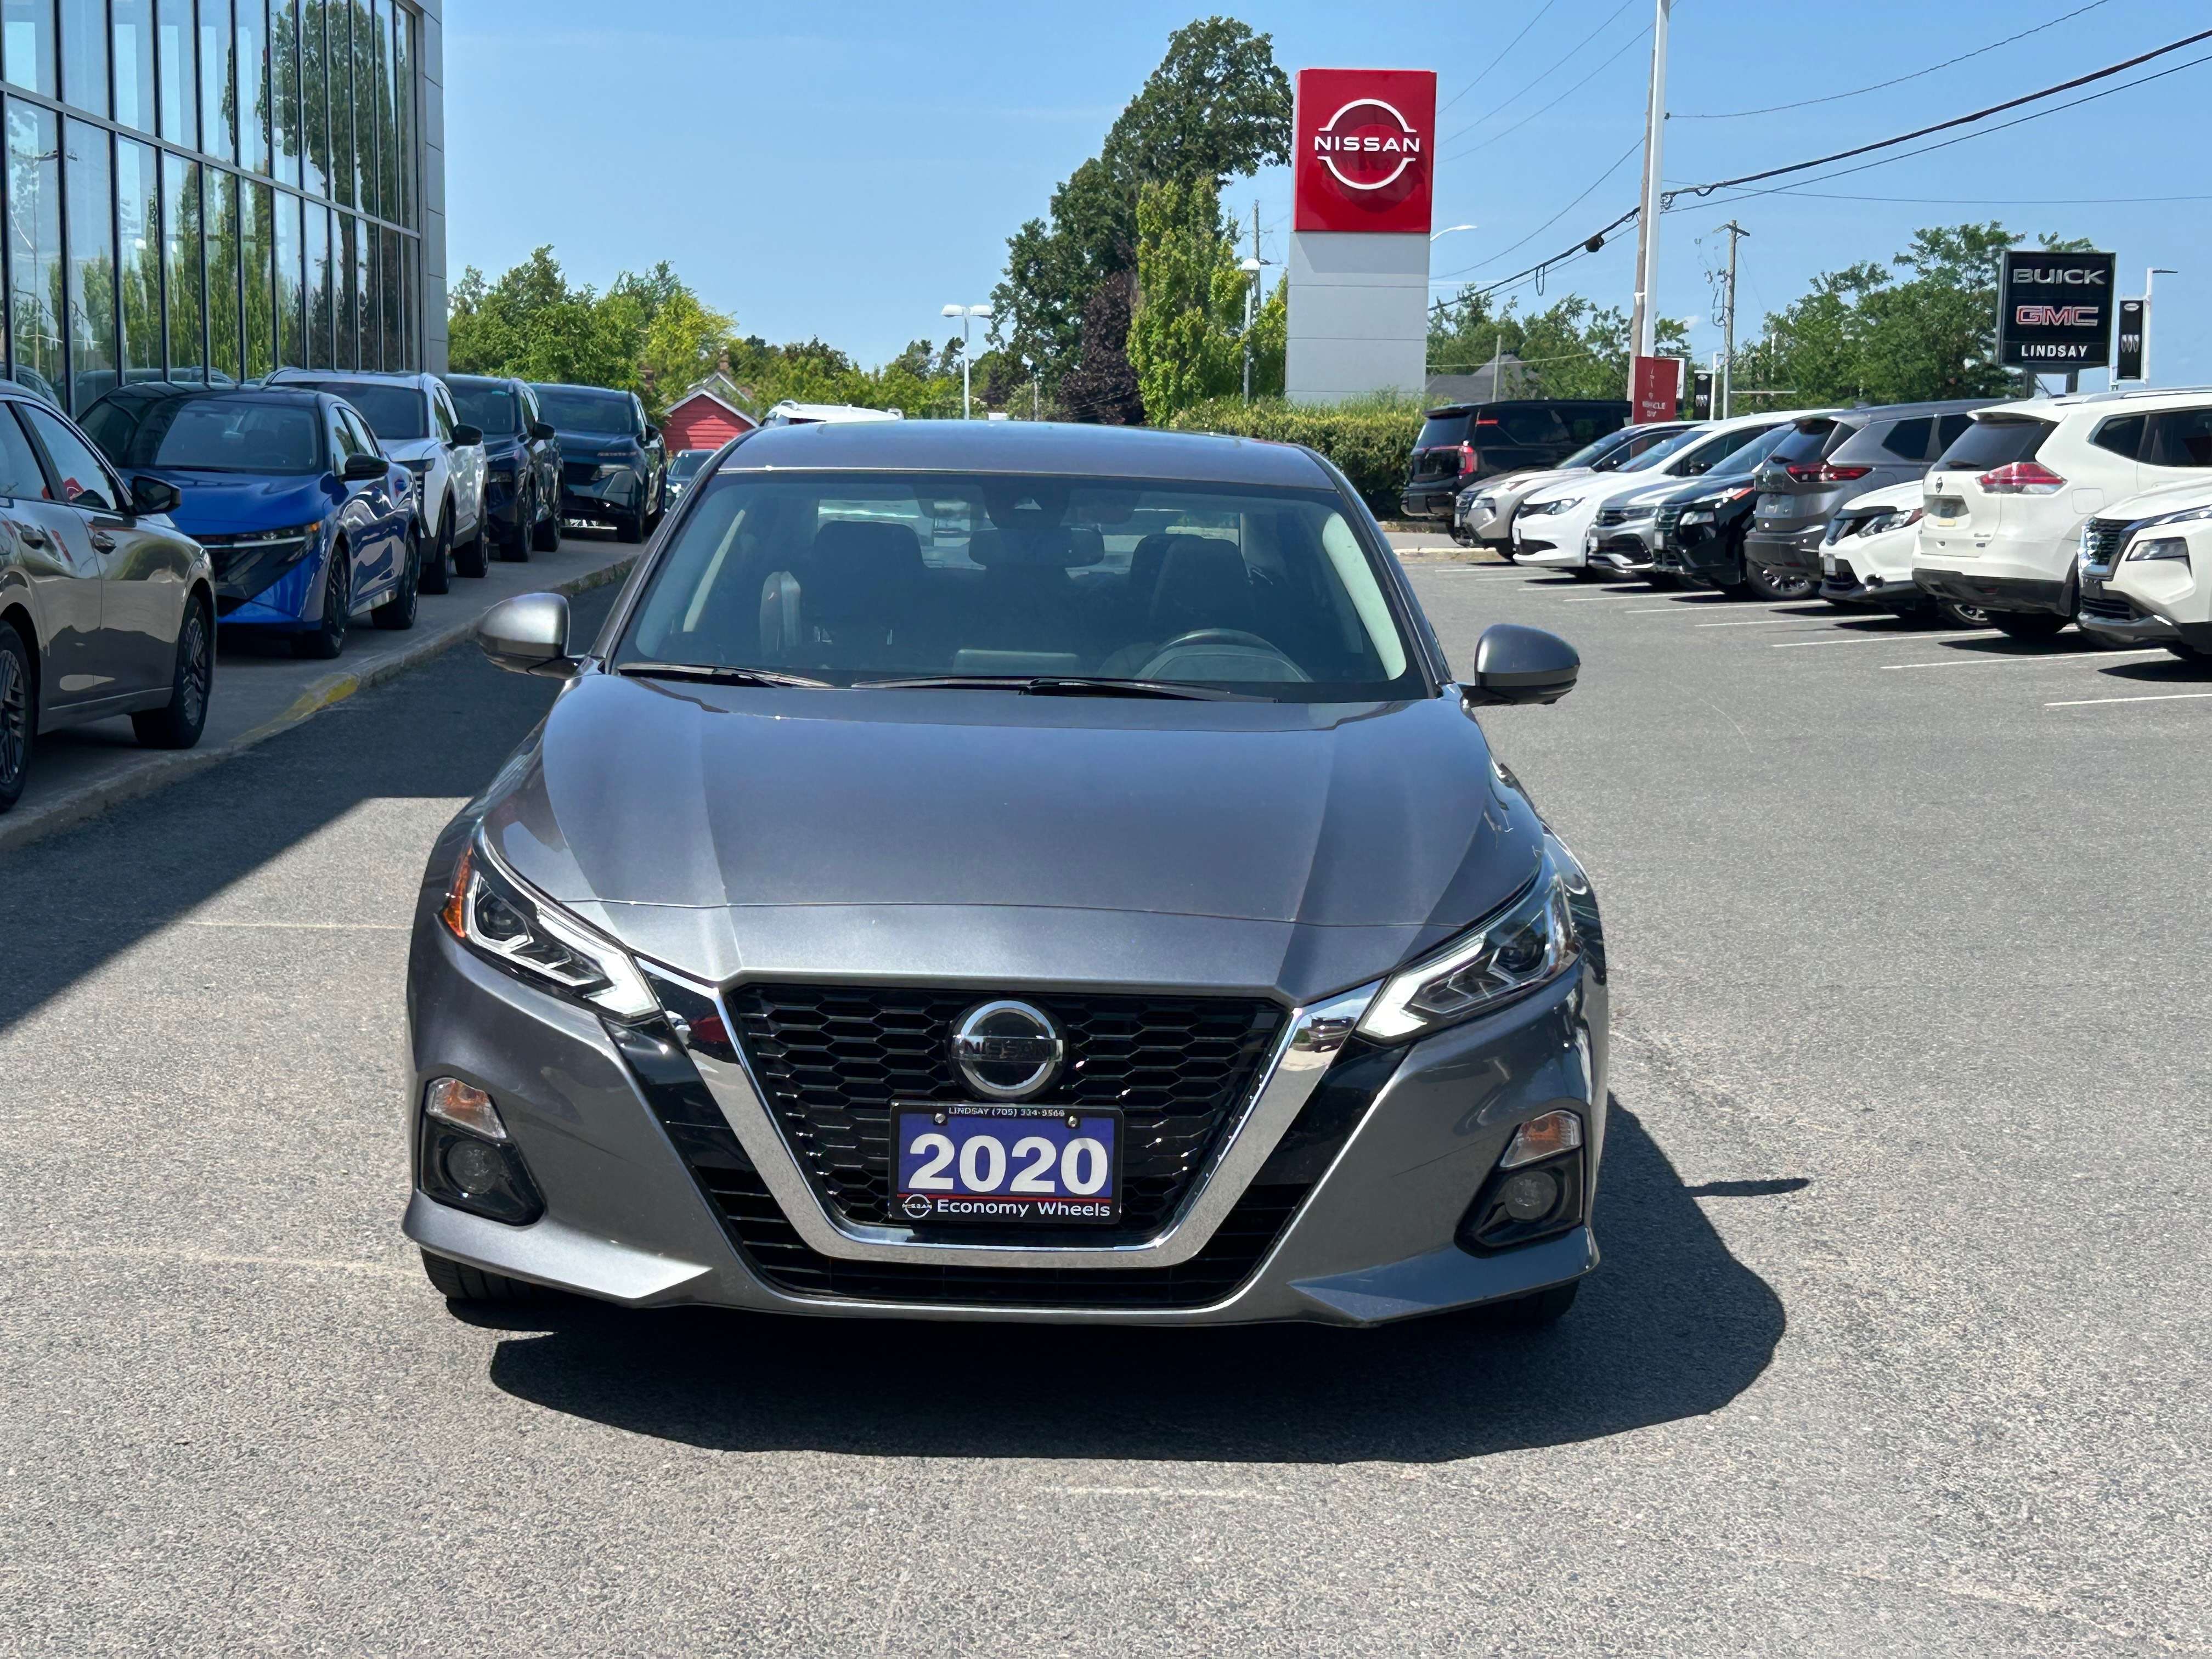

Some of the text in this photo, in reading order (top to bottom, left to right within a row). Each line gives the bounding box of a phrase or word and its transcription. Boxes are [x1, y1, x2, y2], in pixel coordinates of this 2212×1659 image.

[1314, 136, 1420, 153] NISSAN
[2012, 268, 2106, 285] BUICK
[2016, 305, 2099, 326] GMC
[2021, 345, 2088, 358] LINDSAY
[992, 1108, 1017, 1117] (705)
[908, 1133, 1108, 1195] 2020
[937, 1199, 1111, 1217] Economy Wheels
